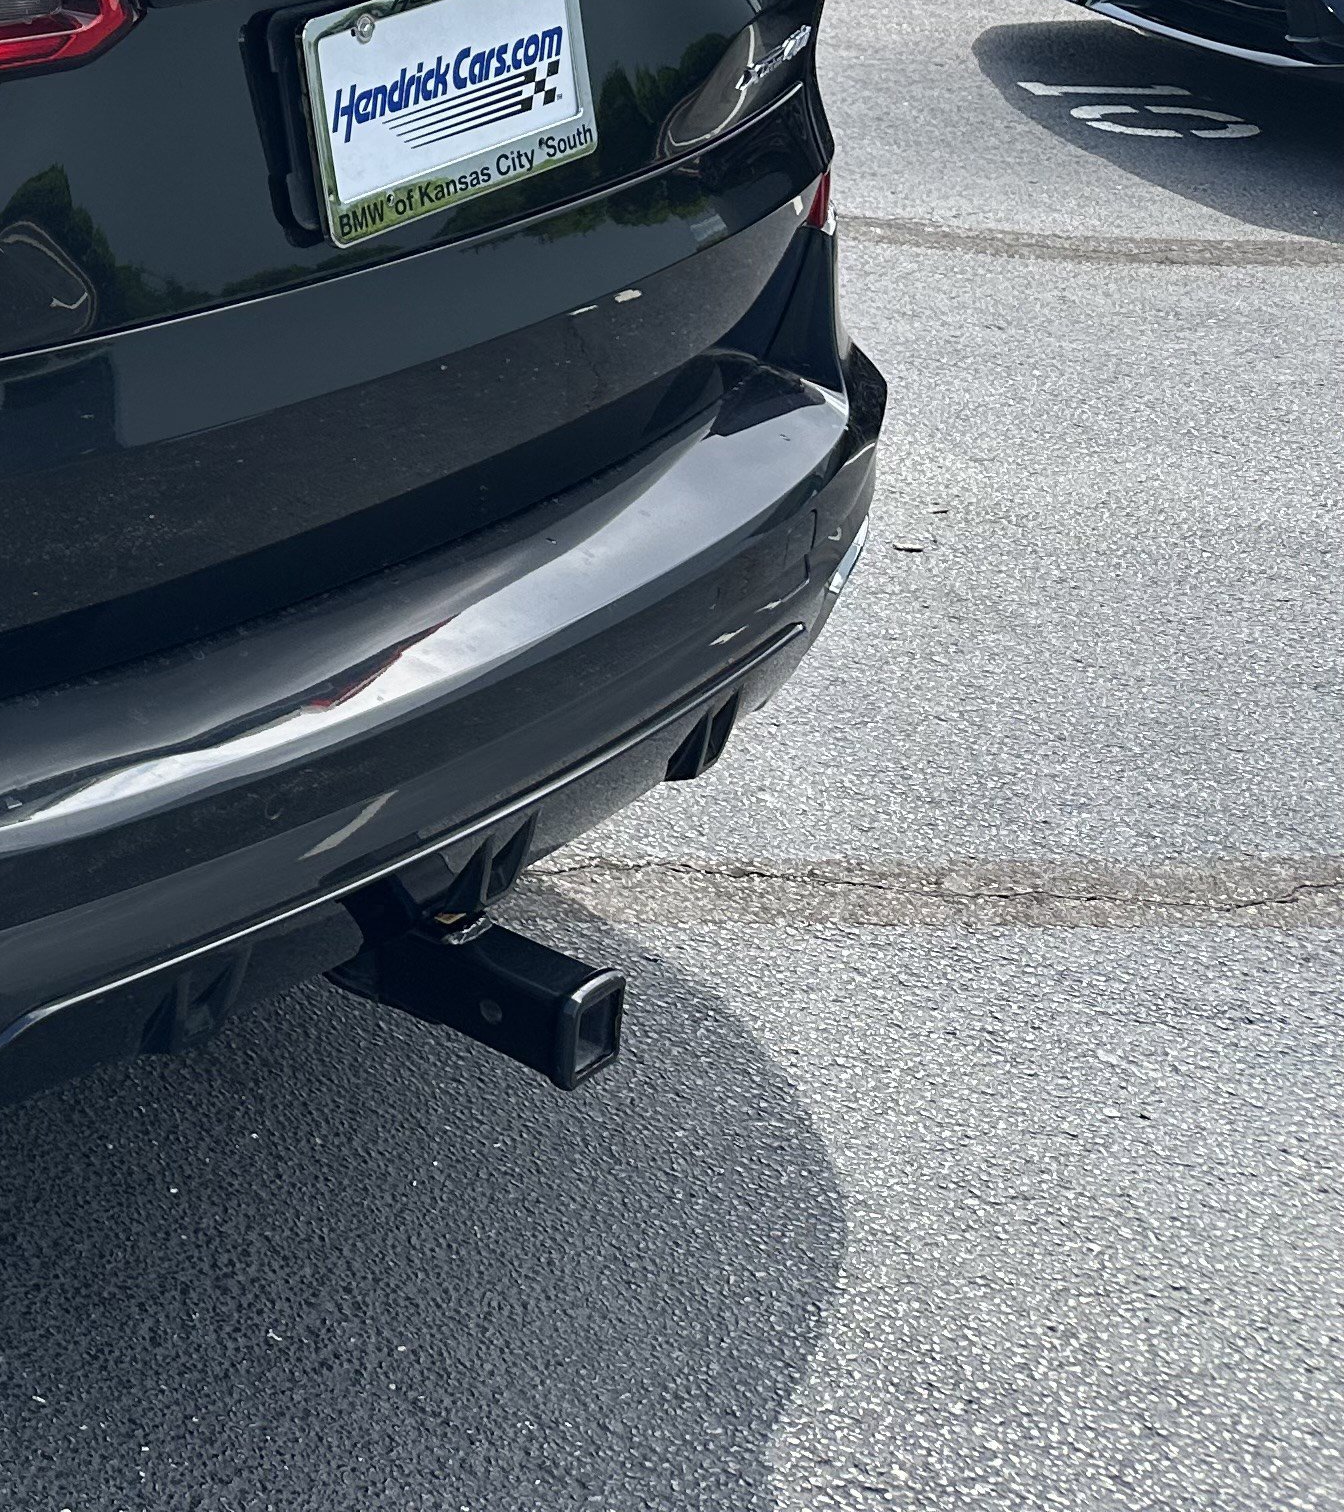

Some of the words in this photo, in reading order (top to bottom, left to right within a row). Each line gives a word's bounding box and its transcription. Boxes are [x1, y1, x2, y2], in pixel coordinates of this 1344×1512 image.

[338, 199, 384, 237] BMW
[395, 192, 414, 216] of
[418, 167, 492, 207] Kansas
[496, 148, 535, 176] City
[544, 124, 594, 158] South
